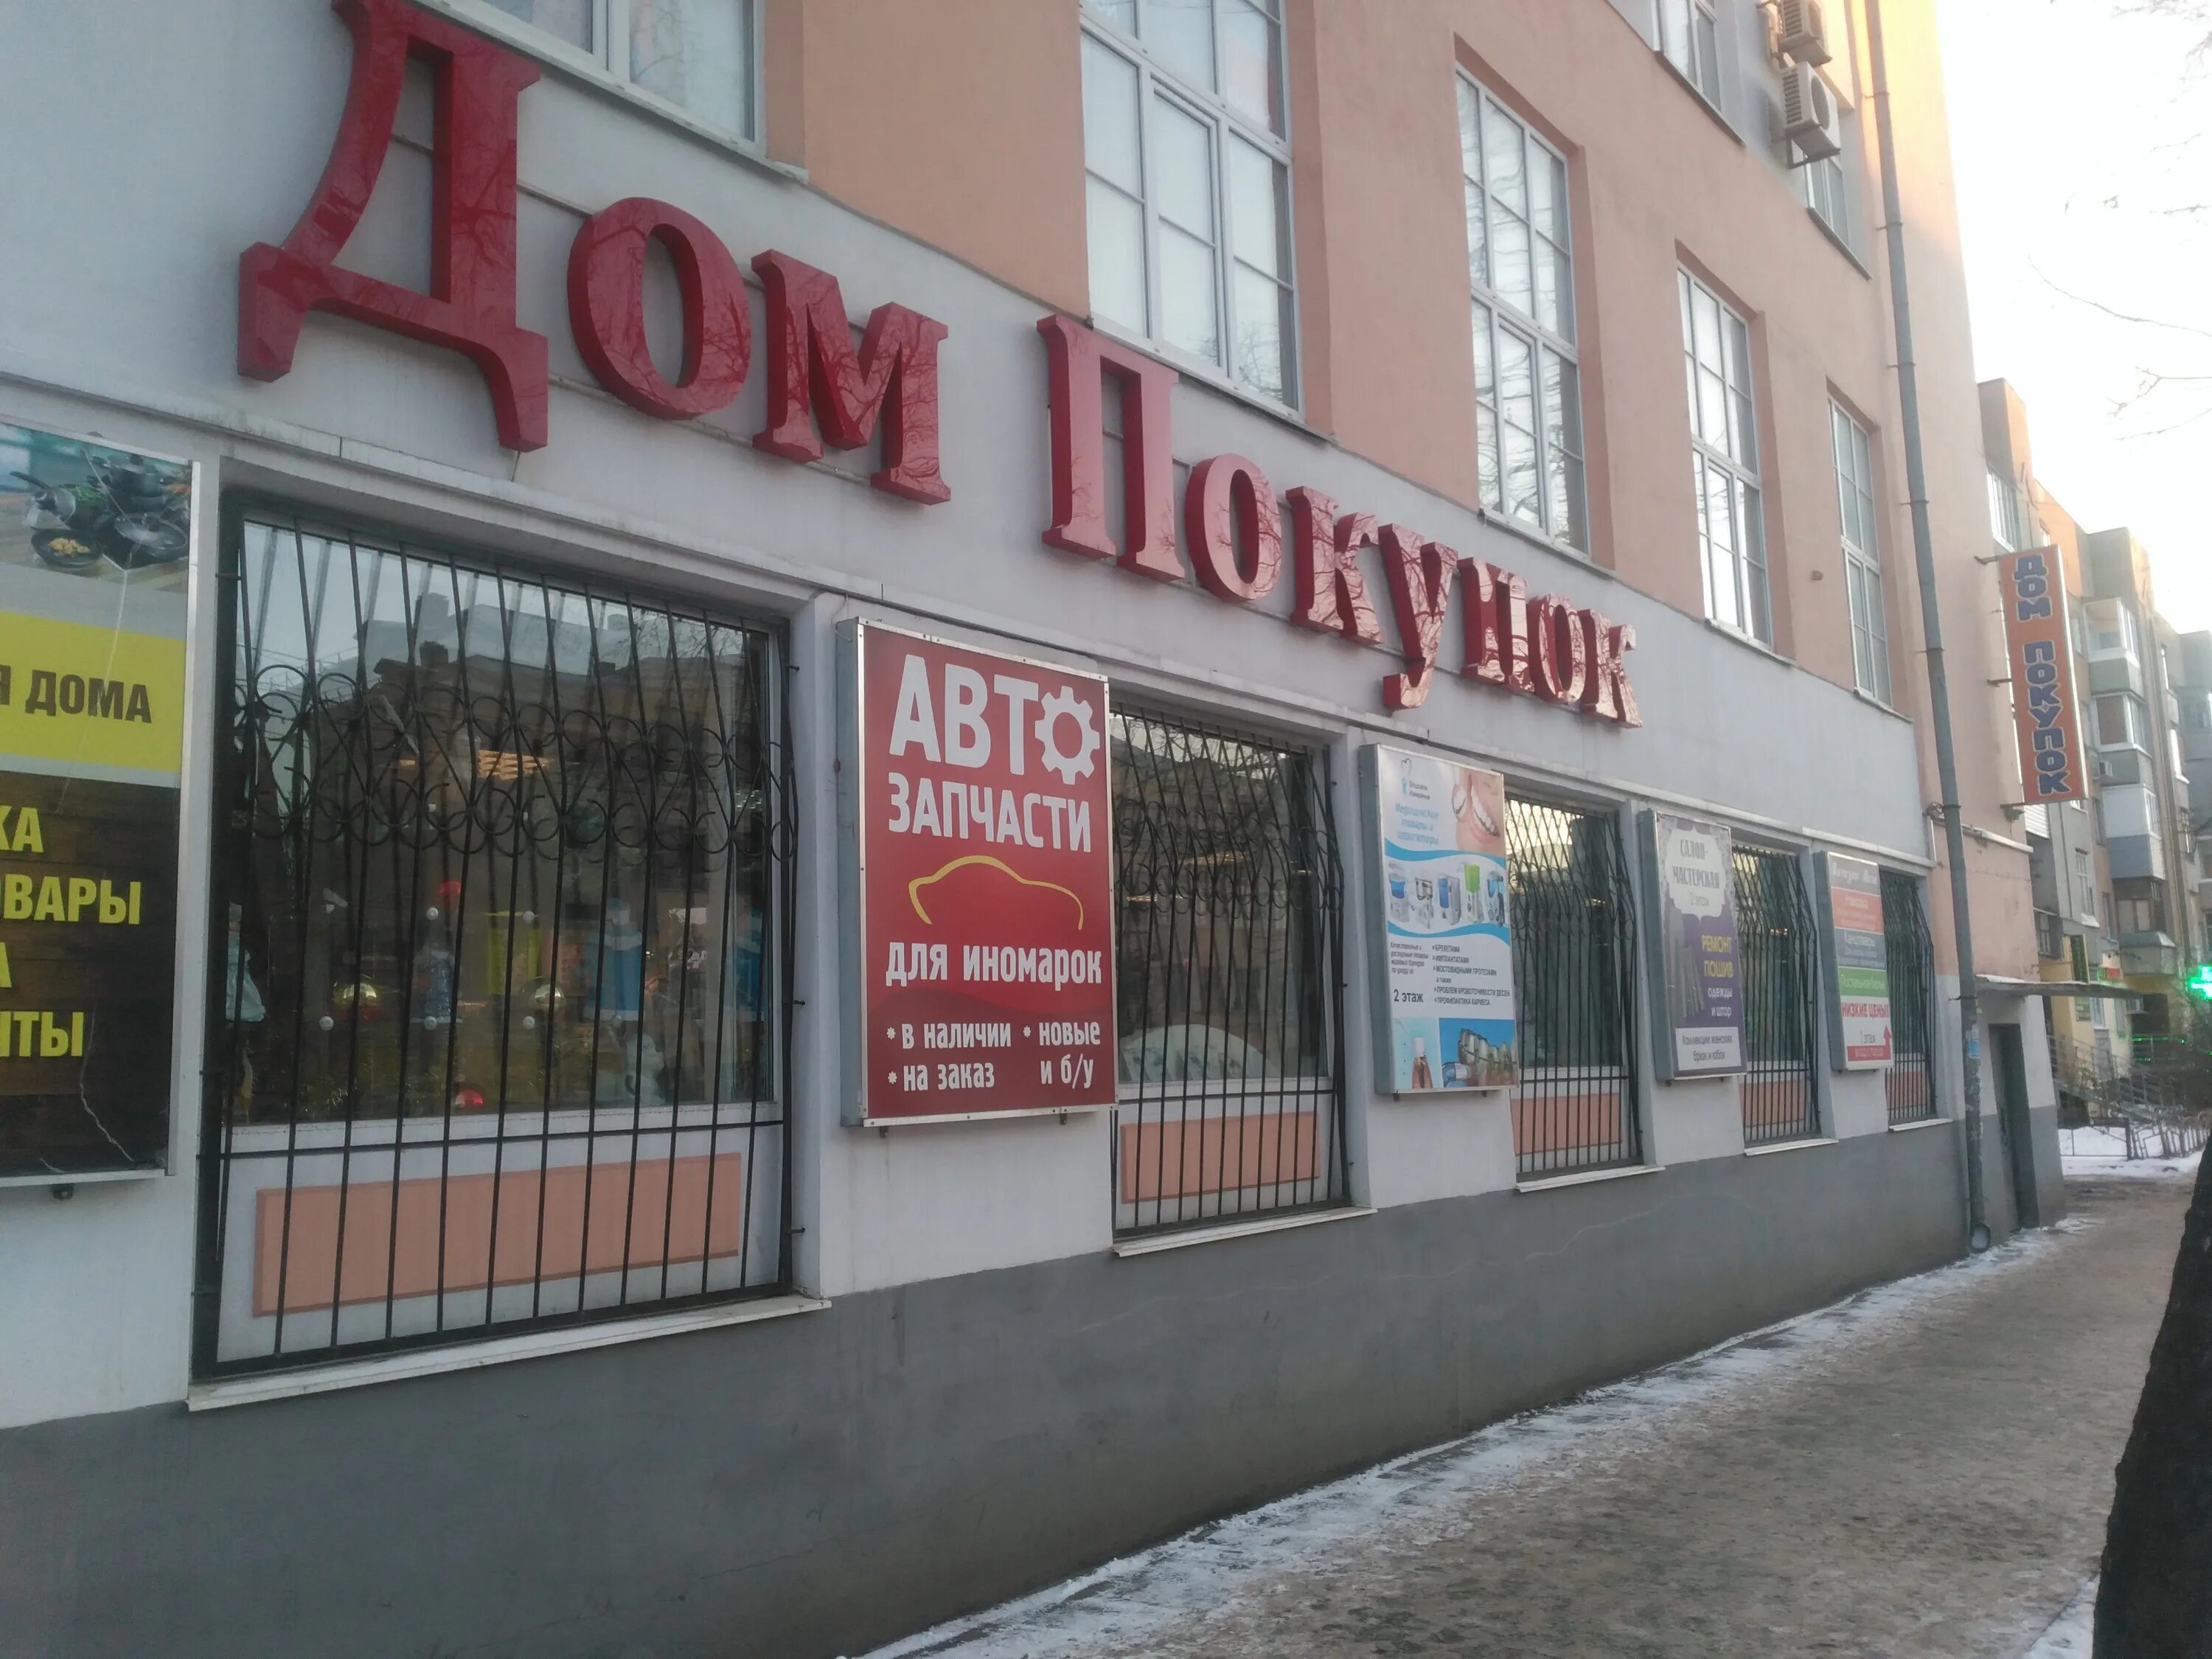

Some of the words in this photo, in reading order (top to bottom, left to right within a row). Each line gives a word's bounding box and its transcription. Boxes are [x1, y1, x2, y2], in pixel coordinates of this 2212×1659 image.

[2012, 554, 2053, 622] ДОМ
[25, 669, 152, 723] ДОМА
[2023, 639, 2071, 796] ПОКУПОК
[888, 771, 1092, 853] ЗАПЧАСТИ
[1701, 934, 1732, 953] РЕМОНТ
[963, 945, 1102, 991] иномарок
[1704, 959, 1733, 978] ПОШИВ
[1394, 988, 1399, 1002] 2
[1402, 992, 1424, 1004] этаж
[1708, 987, 1733, 999] одежды
[1716, 1006, 1732, 1019] штор
[1841, 1002, 1868, 1018] НИЗКИЕ
[923, 1022, 1011, 1048] наличии
[1038, 1021, 1101, 1046] новые
[903, 1064, 928, 1091] на
[937, 1062, 995, 1090] заказ
[1040, 1060, 1052, 1084] и
[1060, 1053, 1093, 1089] б/у
